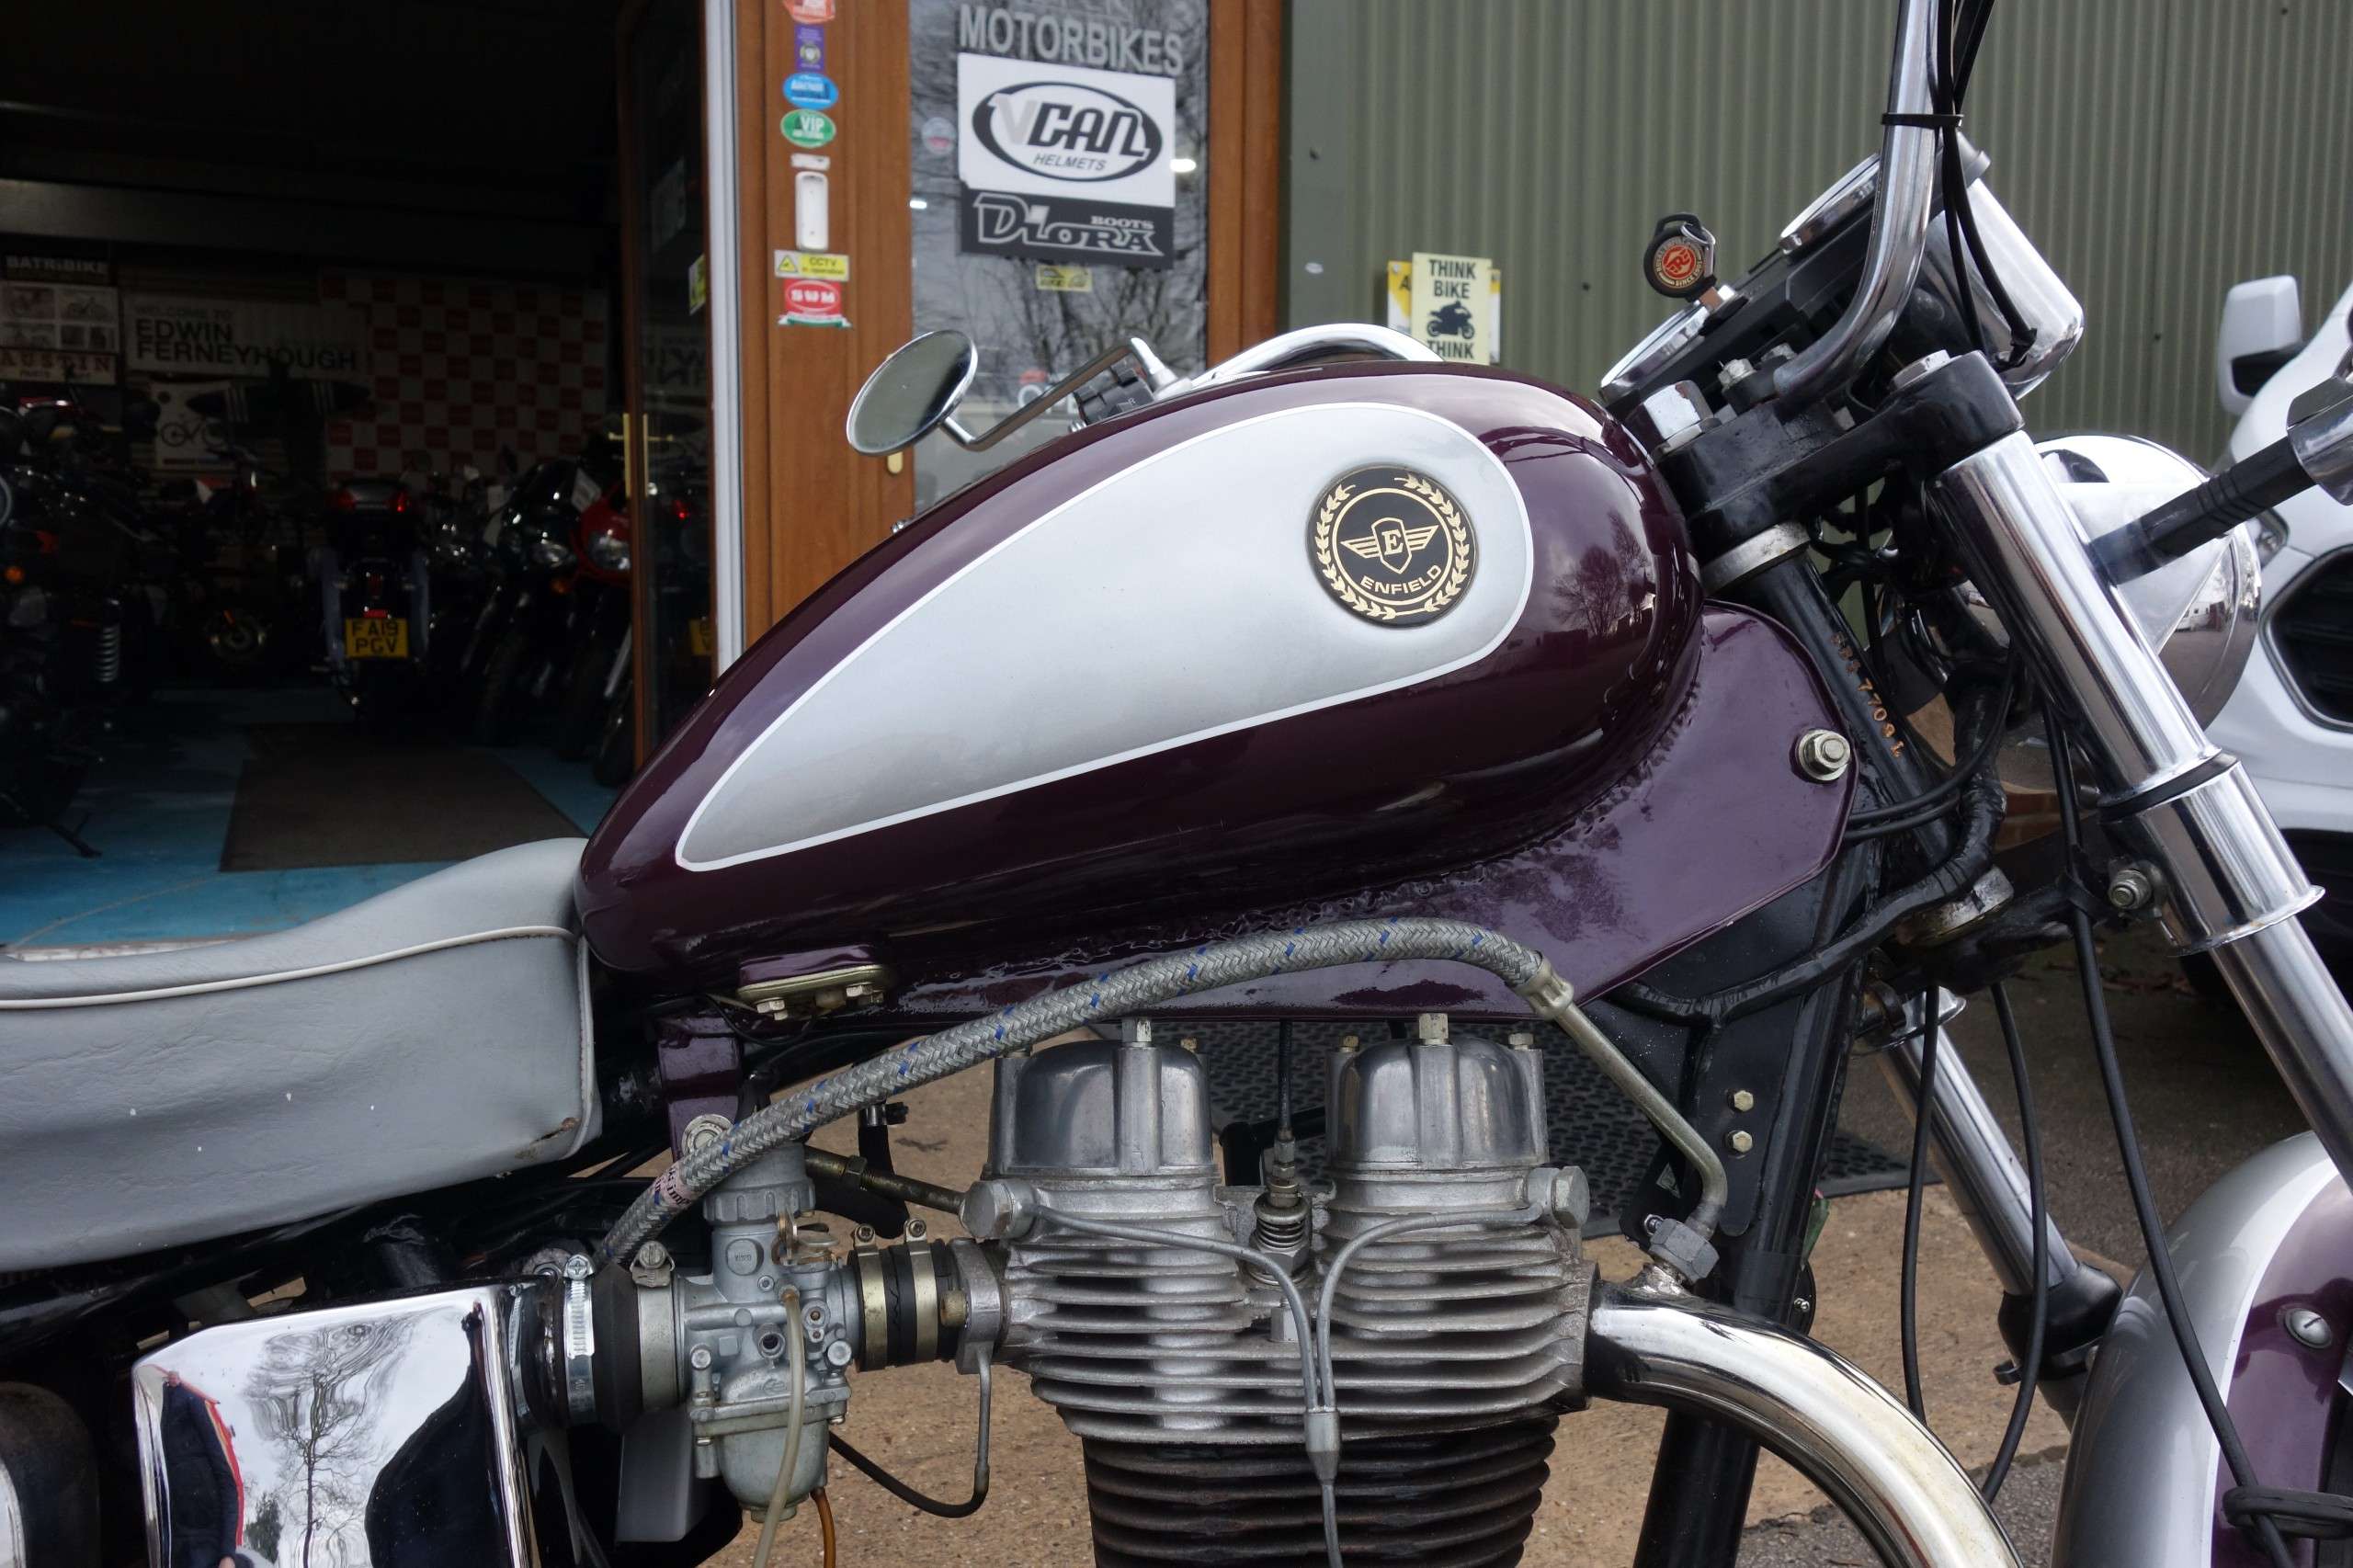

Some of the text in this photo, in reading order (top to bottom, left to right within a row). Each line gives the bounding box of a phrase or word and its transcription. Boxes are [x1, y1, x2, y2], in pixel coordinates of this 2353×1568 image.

[960, 4, 1183, 76] MOTORBIKES
[1032, 153, 1107, 172] HELMETS
[1091, 215, 1154, 230] BOOTS
[809, 257, 837, 267] CCTV
[1428, 259, 1476, 279] THINK
[1434, 280, 1471, 299] BIKE
[135, 318, 233, 343] EDWIN
[136, 340, 357, 370] FERNEYHOUGH
[1427, 340, 1474, 359] THINK
[1381, 528, 1404, 555] E
[1359, 564, 1442, 595] ENFIELD
